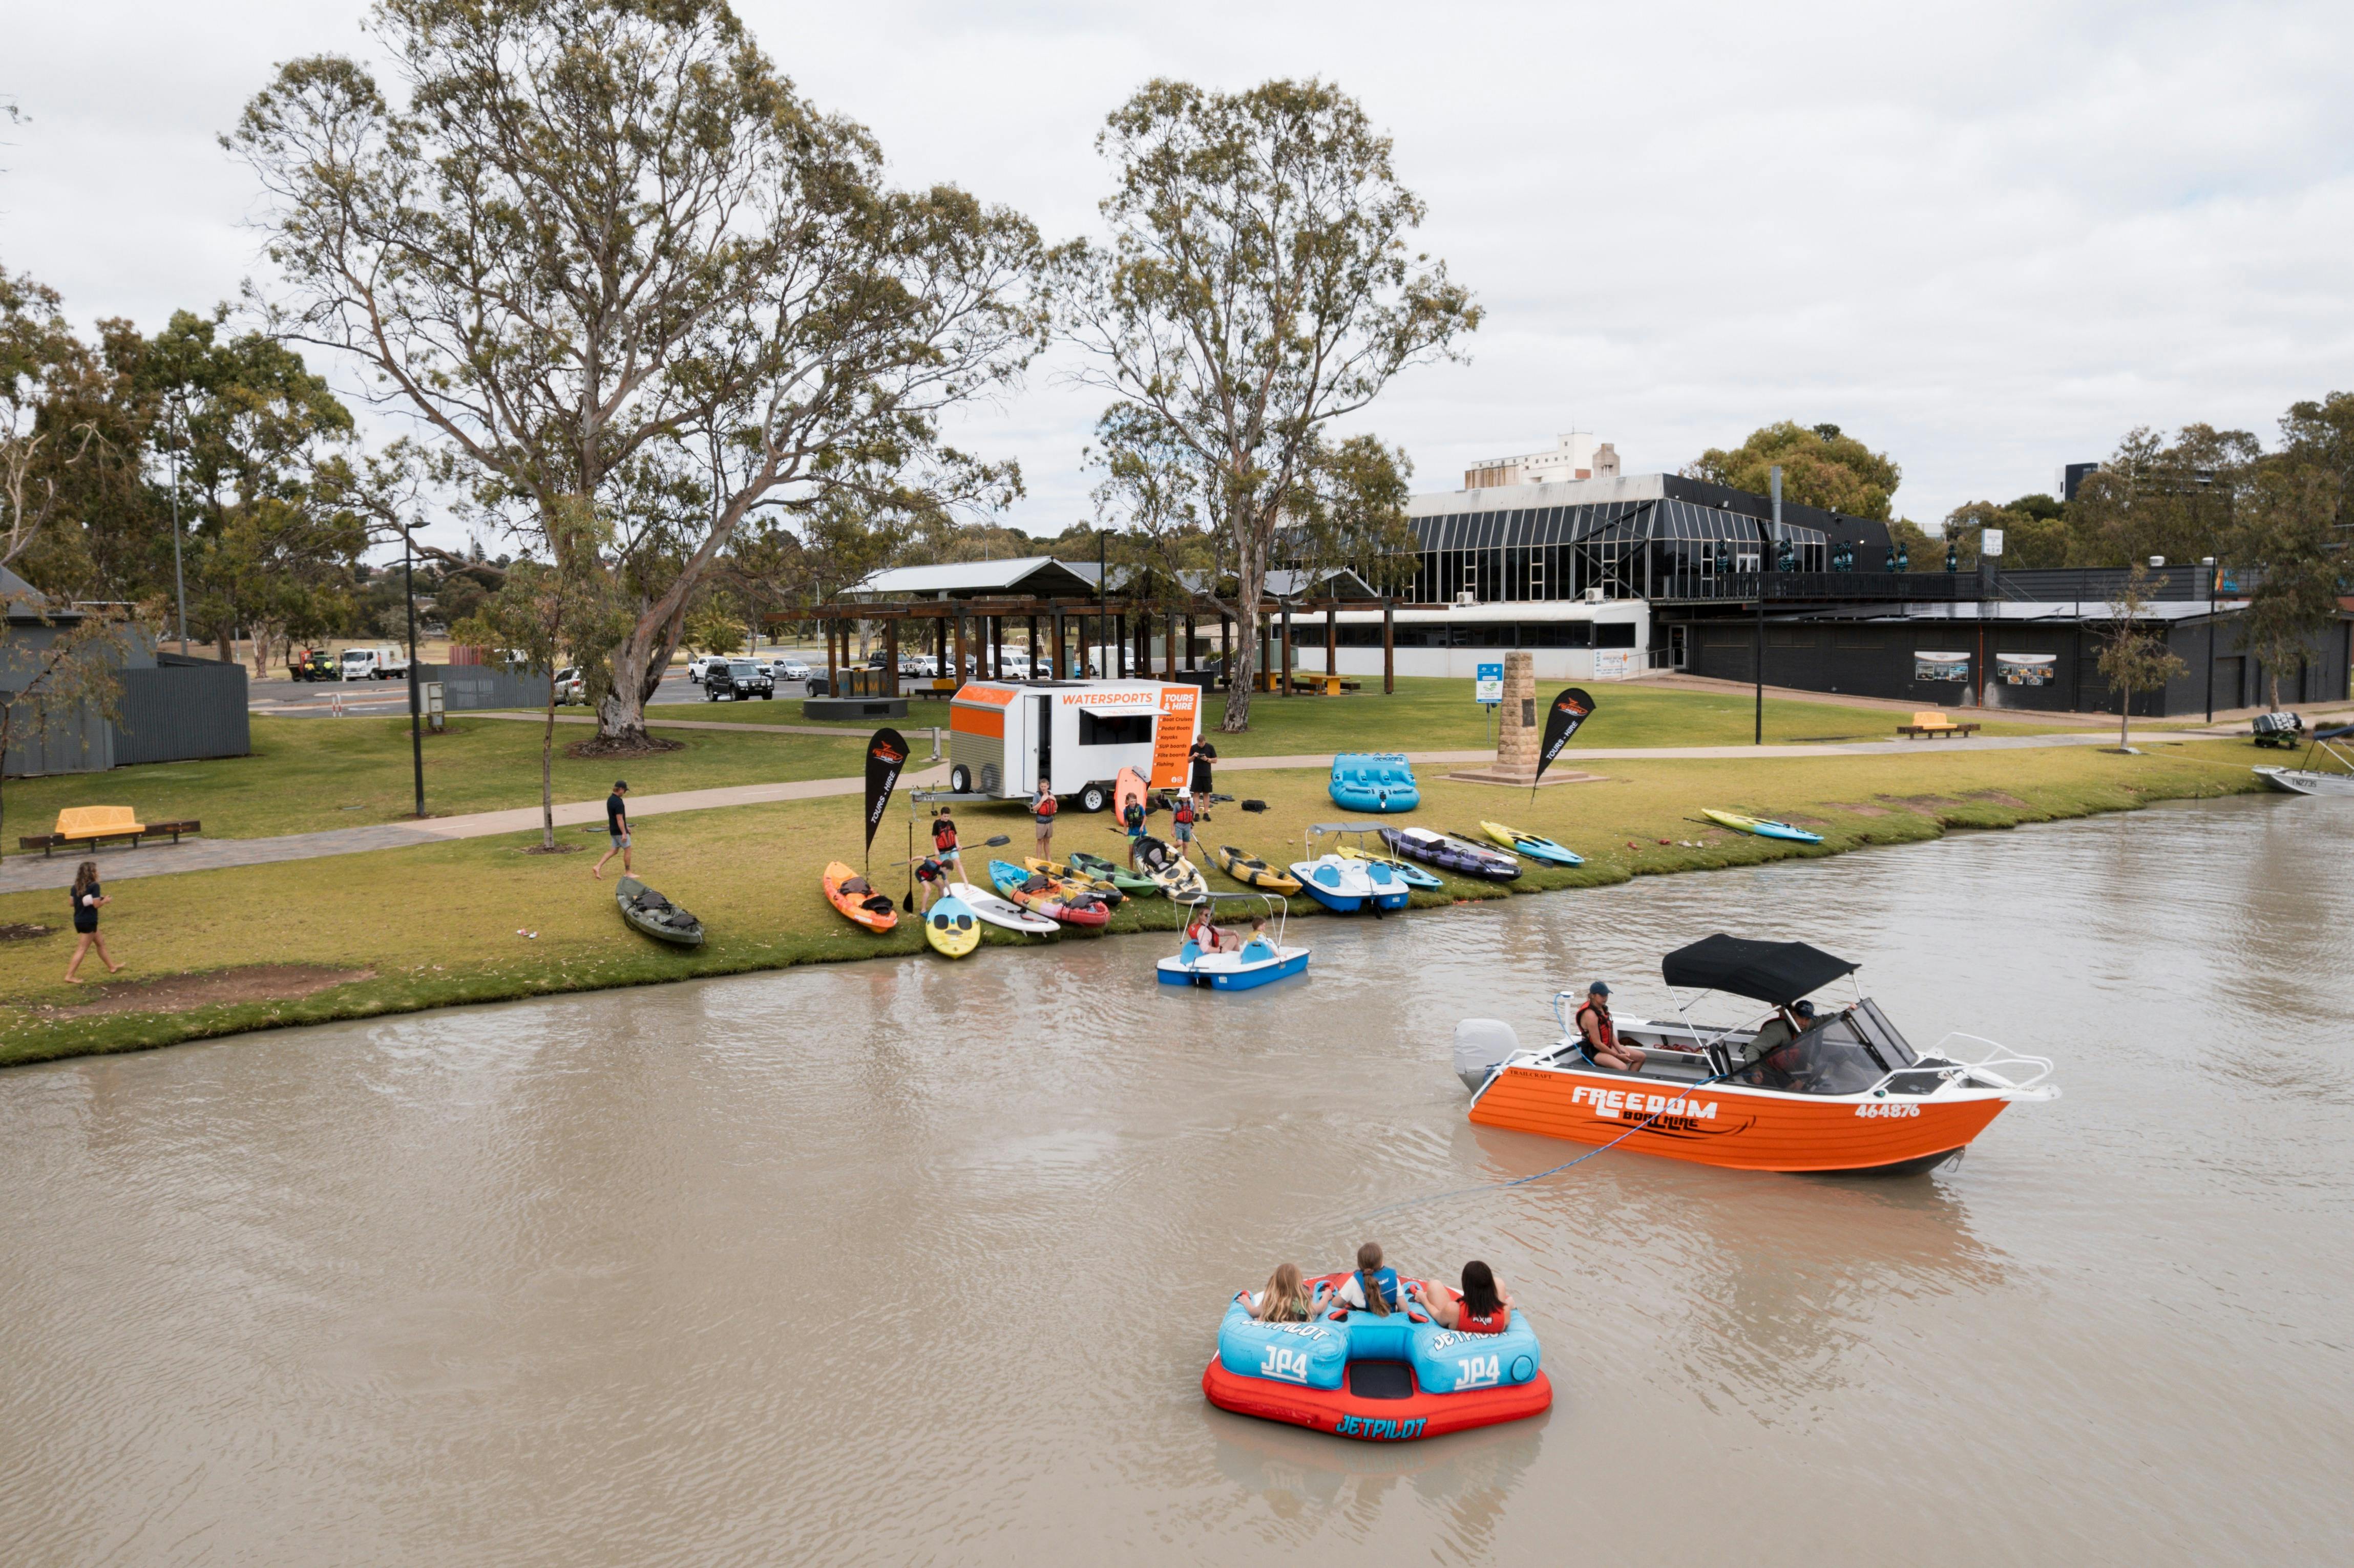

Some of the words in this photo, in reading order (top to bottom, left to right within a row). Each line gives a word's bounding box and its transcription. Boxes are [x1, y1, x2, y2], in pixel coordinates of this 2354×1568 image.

[1062, 693, 1152, 705] WATERSPORTS
[1165, 694, 1194, 702] TOURS
[1546, 739, 1564, 759] TOURS
[1564, 721, 1578, 736] HIRE
[871, 796, 885, 823] TOURS
[884, 770, 896, 792] HIRE
[1509, 1070, 1552, 1079] TRAILCRAFT
[1572, 1086, 1718, 1119] FREEDOM
[1855, 1104, 1920, 1118] 464876
[1261, 1345, 1307, 1379] JP4
[1456, 1354, 1500, 1385] JP4
[1336, 1414, 1427, 1439] JETPILOT
